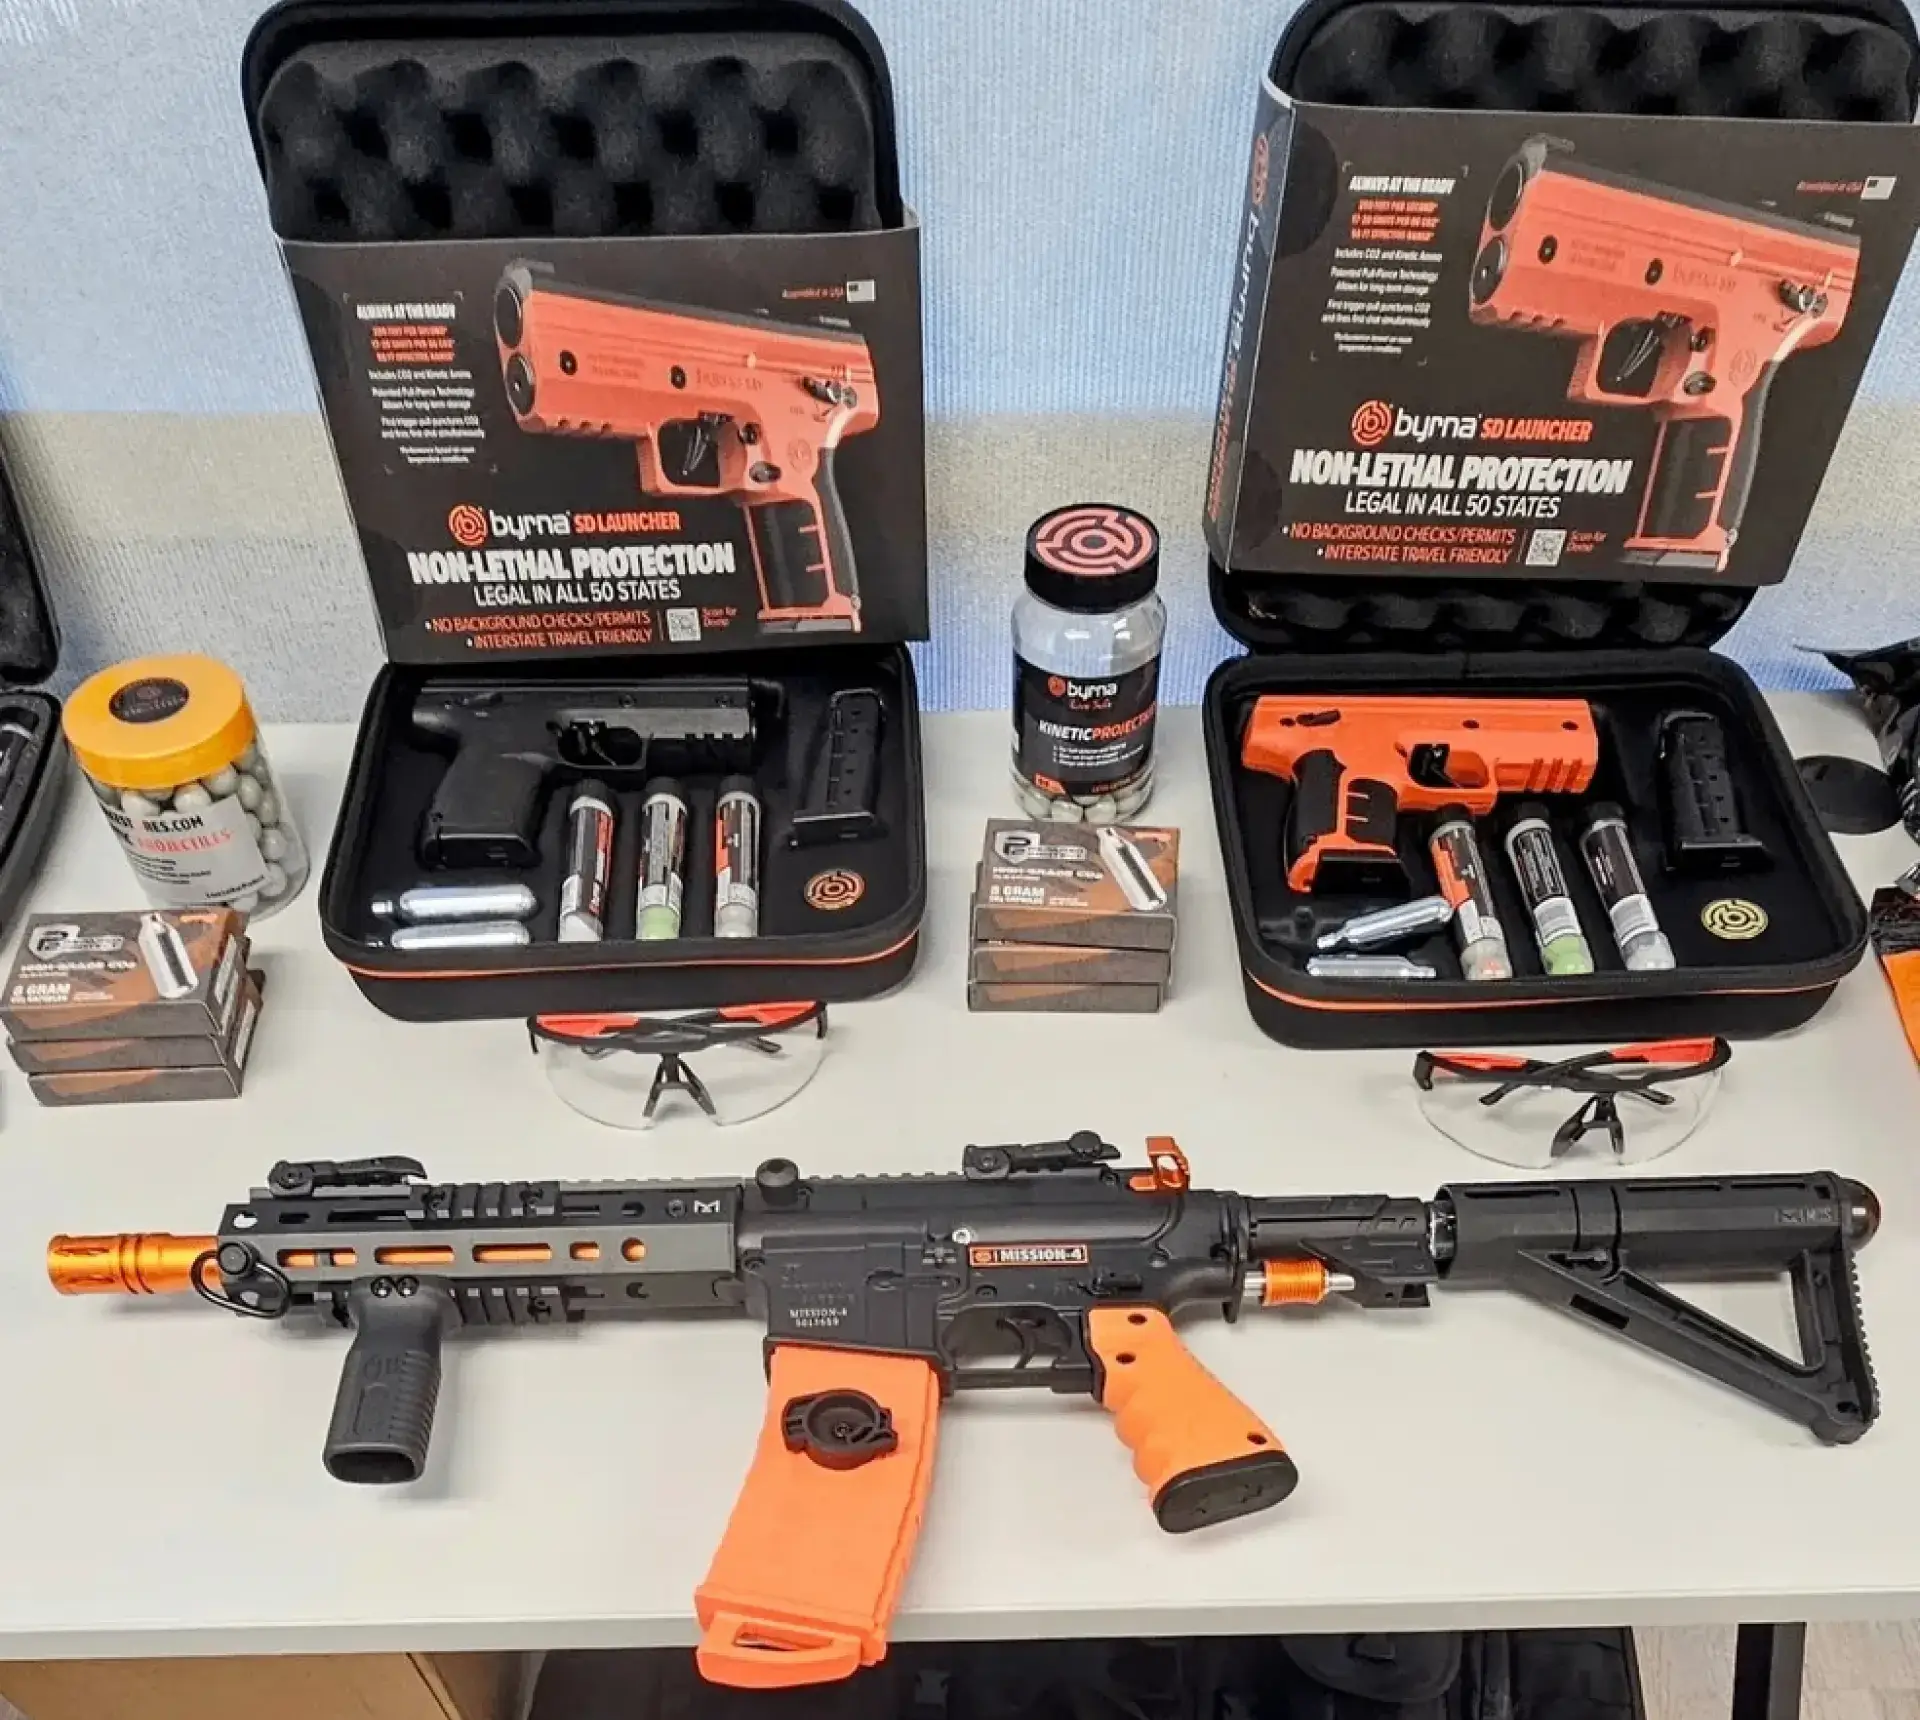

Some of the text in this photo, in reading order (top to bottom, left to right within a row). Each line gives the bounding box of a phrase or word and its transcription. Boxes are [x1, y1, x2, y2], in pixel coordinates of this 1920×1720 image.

[1394, 408, 1593, 443] byrna SD LAUNCHER
[1290, 449, 1633, 494] NON-LETHAL PROTECTION
[1345, 491, 1561, 518] LEGAL IN ALL 50 STATES
[490, 509, 681, 541] byrna SD LAUNCHER
[1290, 522, 1517, 544] NO BACKGROUND CHECKS/PERMITS
[407, 542, 736, 585] NON-LETHAL PROTECTION
[1324, 544, 1512, 564] INTERSTATE TRAVEL FRIENDLY
[474, 579, 681, 607] LEGAL IN ALL 50 STATES
[432, 610, 651, 632] NO BACKGROUND CHECKS/PERMITS
[474, 629, 653, 649] INTERSTATE TRAVEL FRIENDLY
[1067, 681, 1117, 702] byrna
[1039, 719, 1093, 741] KINETIC
[1000, 1247, 1082, 1262] MISSION-4
